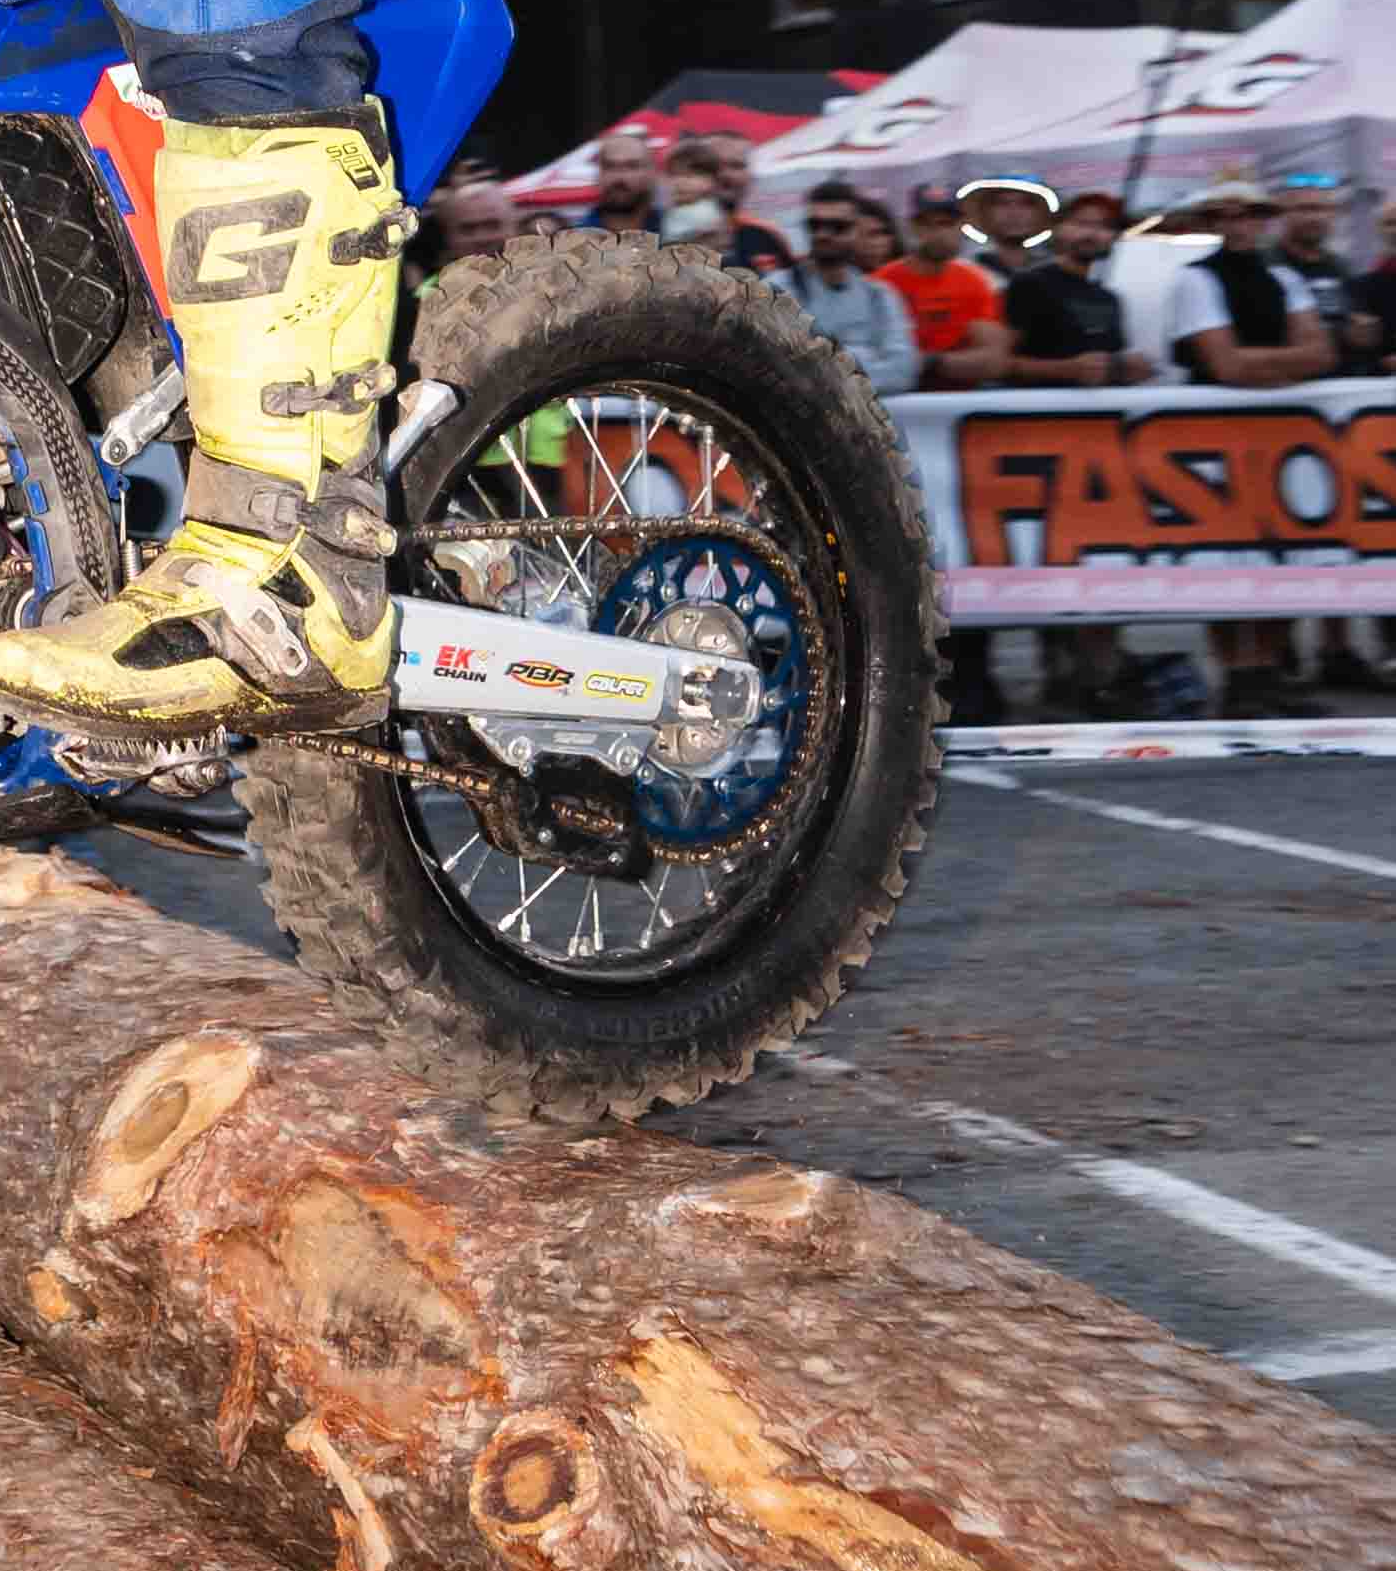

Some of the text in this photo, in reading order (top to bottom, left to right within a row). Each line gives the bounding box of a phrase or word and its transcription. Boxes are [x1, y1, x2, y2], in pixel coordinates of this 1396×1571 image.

[436, 644, 473, 667] EK
[433, 666, 487, 683] CHAIN
[504, 661, 576, 687] PBR
